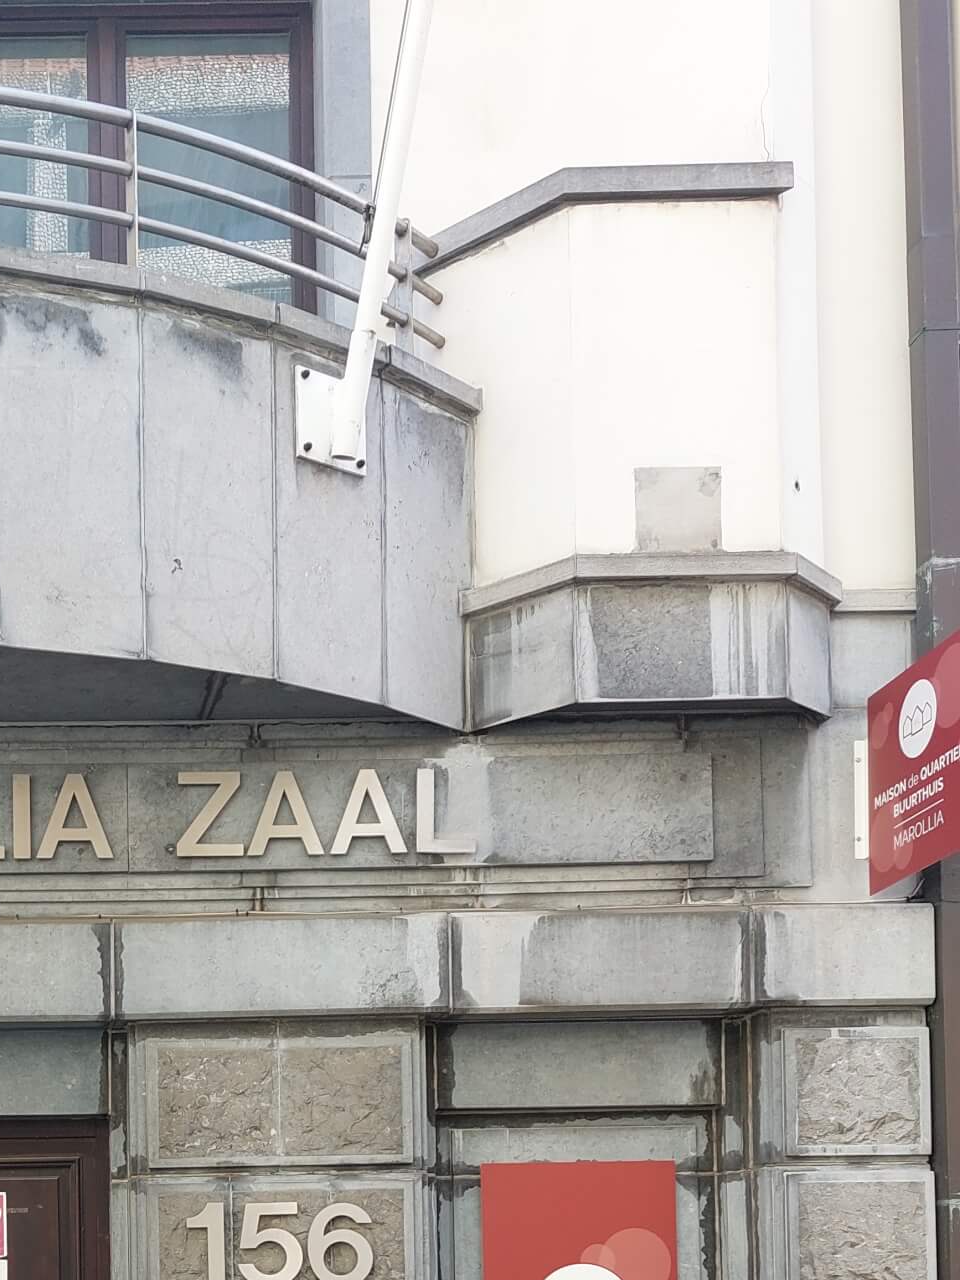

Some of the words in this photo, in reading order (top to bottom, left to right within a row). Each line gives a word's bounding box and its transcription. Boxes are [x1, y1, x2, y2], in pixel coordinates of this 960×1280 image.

[874, 779, 907, 810] MAISON
[907, 773, 920, 788] de
[893, 777, 944, 818] BUURTHUIS
[176, 767, 478, 859] ZAAL
[893, 809, 945, 850] MAROLLIA
